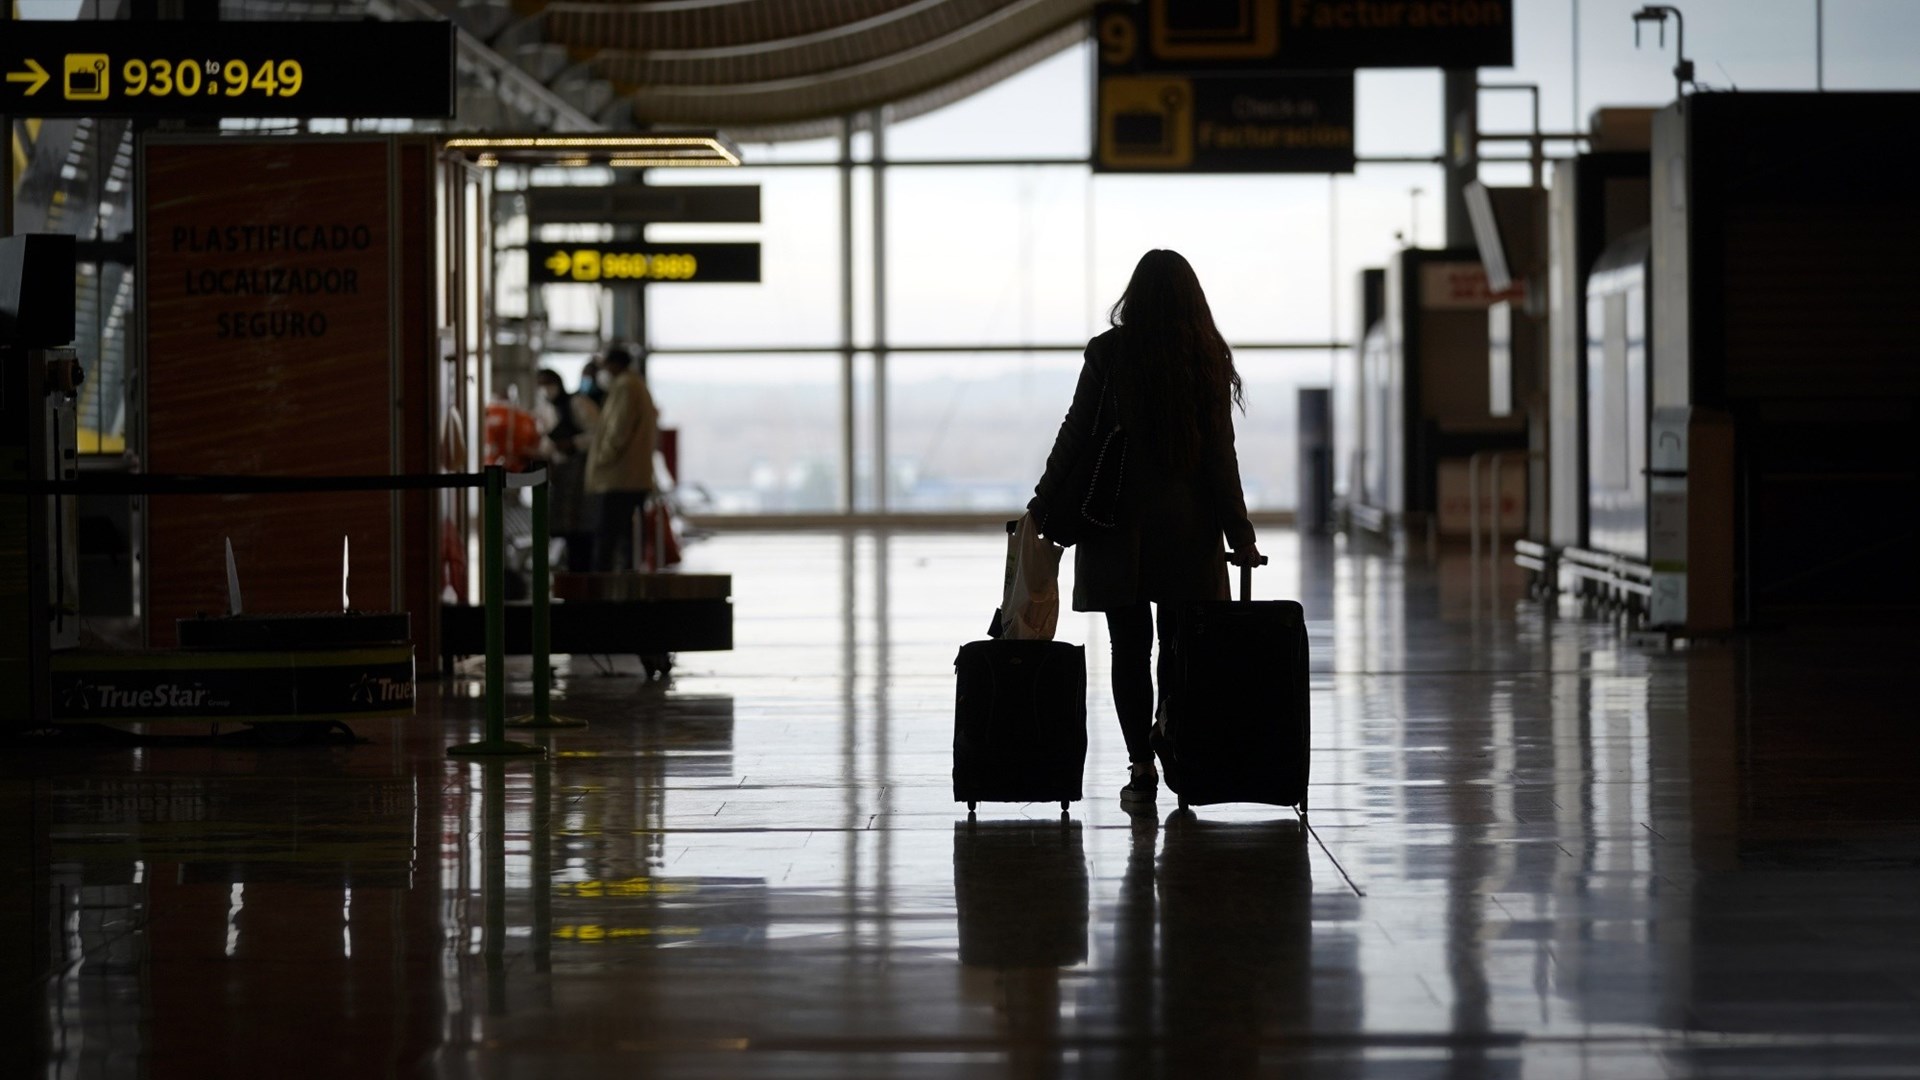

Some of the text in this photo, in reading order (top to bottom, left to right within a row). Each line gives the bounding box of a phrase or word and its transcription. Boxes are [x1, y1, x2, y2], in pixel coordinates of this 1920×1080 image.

[123, 58, 303, 97] 930 to a 949
[172, 225, 371, 251] PLASTIFICADO
[185, 268, 358, 295] LOCALIZADOR
[217, 311, 327, 337] SEGURO
[97, 685, 206, 708] TrueStar
